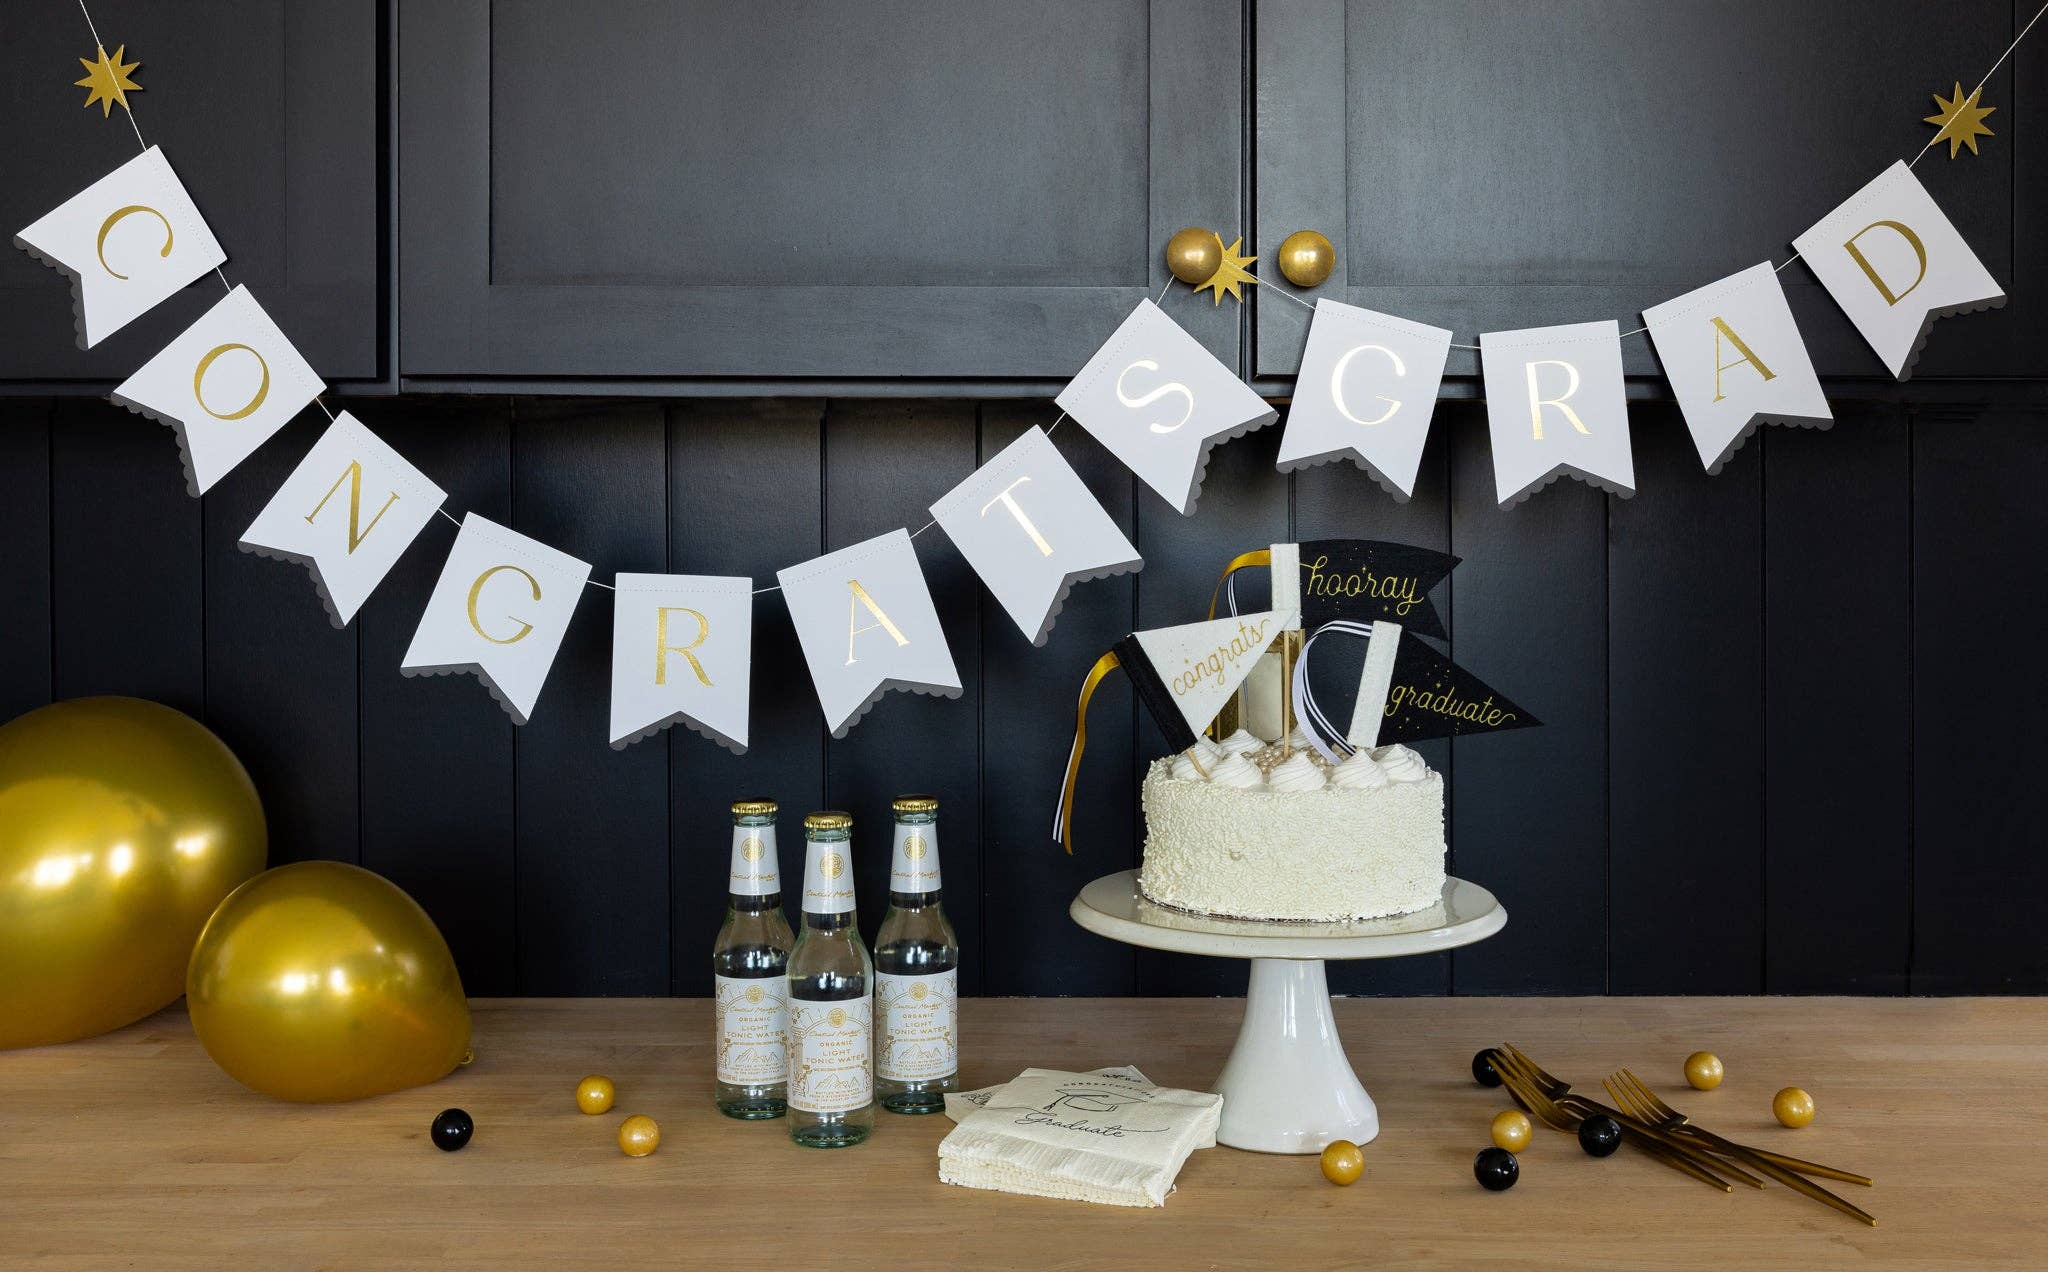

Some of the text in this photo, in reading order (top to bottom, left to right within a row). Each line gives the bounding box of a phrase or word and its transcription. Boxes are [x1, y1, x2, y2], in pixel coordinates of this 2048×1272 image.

[97, 205, 1927, 687] CONGRATS GRAD
[1300, 555, 1425, 616] hooray
[1172, 618, 1272, 697] congrats
[1384, 681, 1516, 727] graduate
[741, 1024, 769, 1032] LIGHT
[890, 1025, 947, 1036] TONIC WATER
[727, 1029, 785, 1039] TONIC WATER
[819, 1040, 853, 1048] ORGANIC
[822, 1048, 851, 1057] LIGHT
[805, 1053, 866, 1065] TONIC WATER
